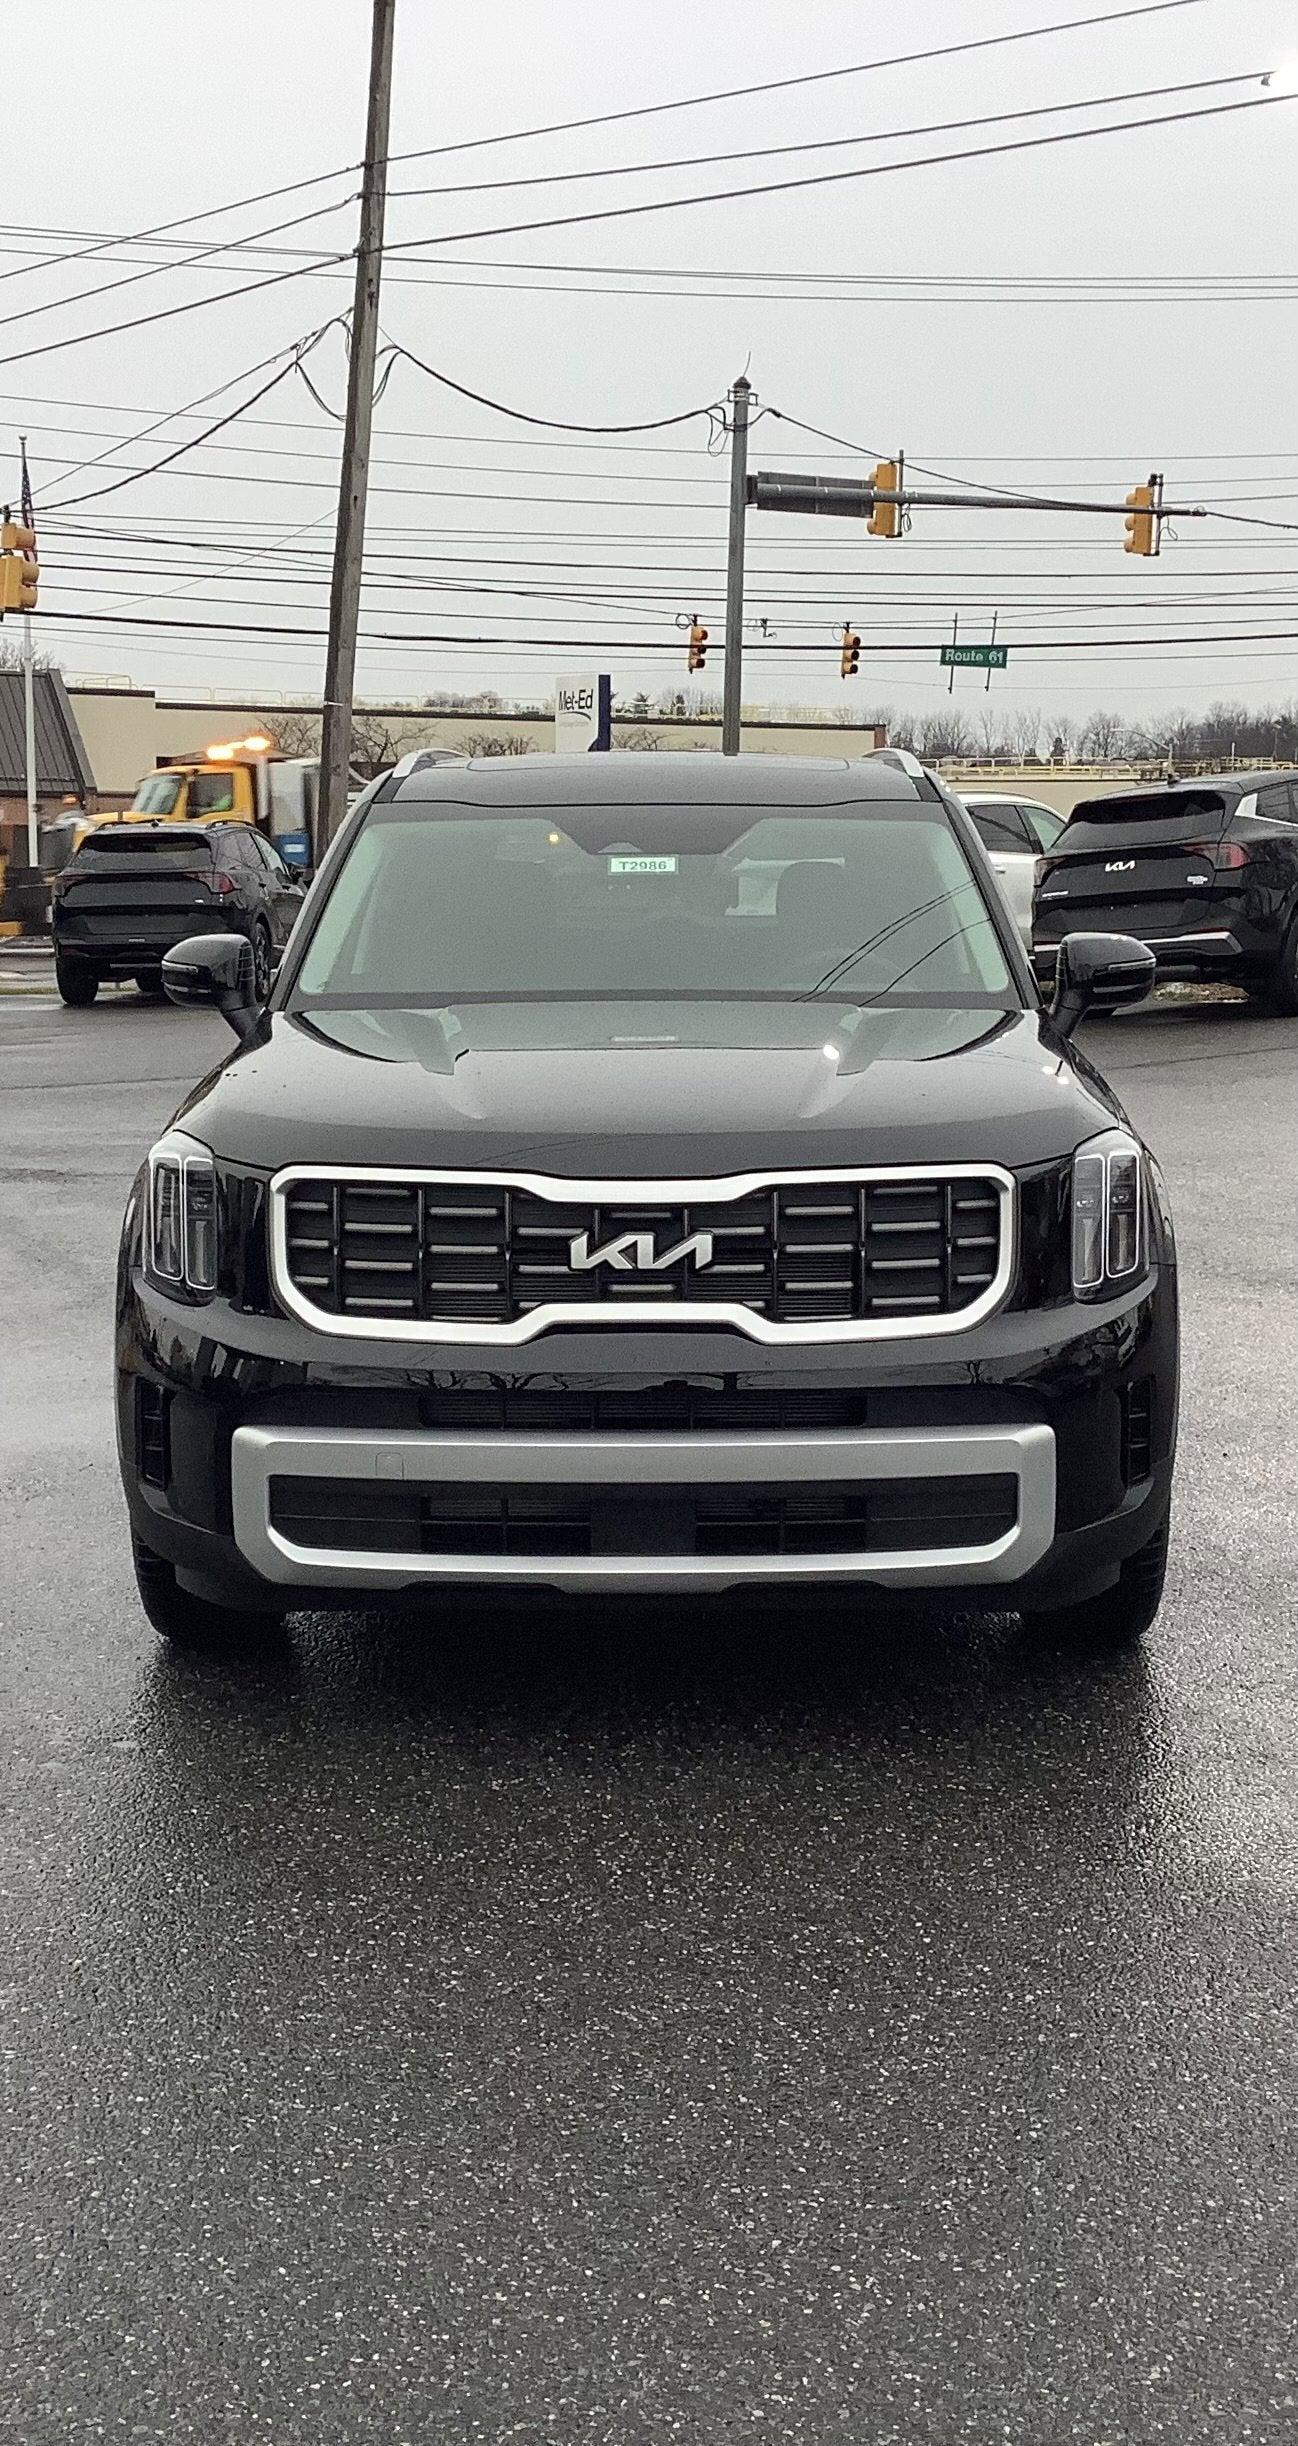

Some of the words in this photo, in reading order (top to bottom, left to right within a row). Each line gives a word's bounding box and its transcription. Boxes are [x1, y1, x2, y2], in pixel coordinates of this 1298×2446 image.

[945, 648, 984, 662] Route
[988, 650, 1004, 664] 61
[558, 688, 594, 711] Met-Ed
[618, 860, 668, 871] T2986
[1104, 860, 1136, 872] KIA
[568, 1231, 715, 1270] KIA
